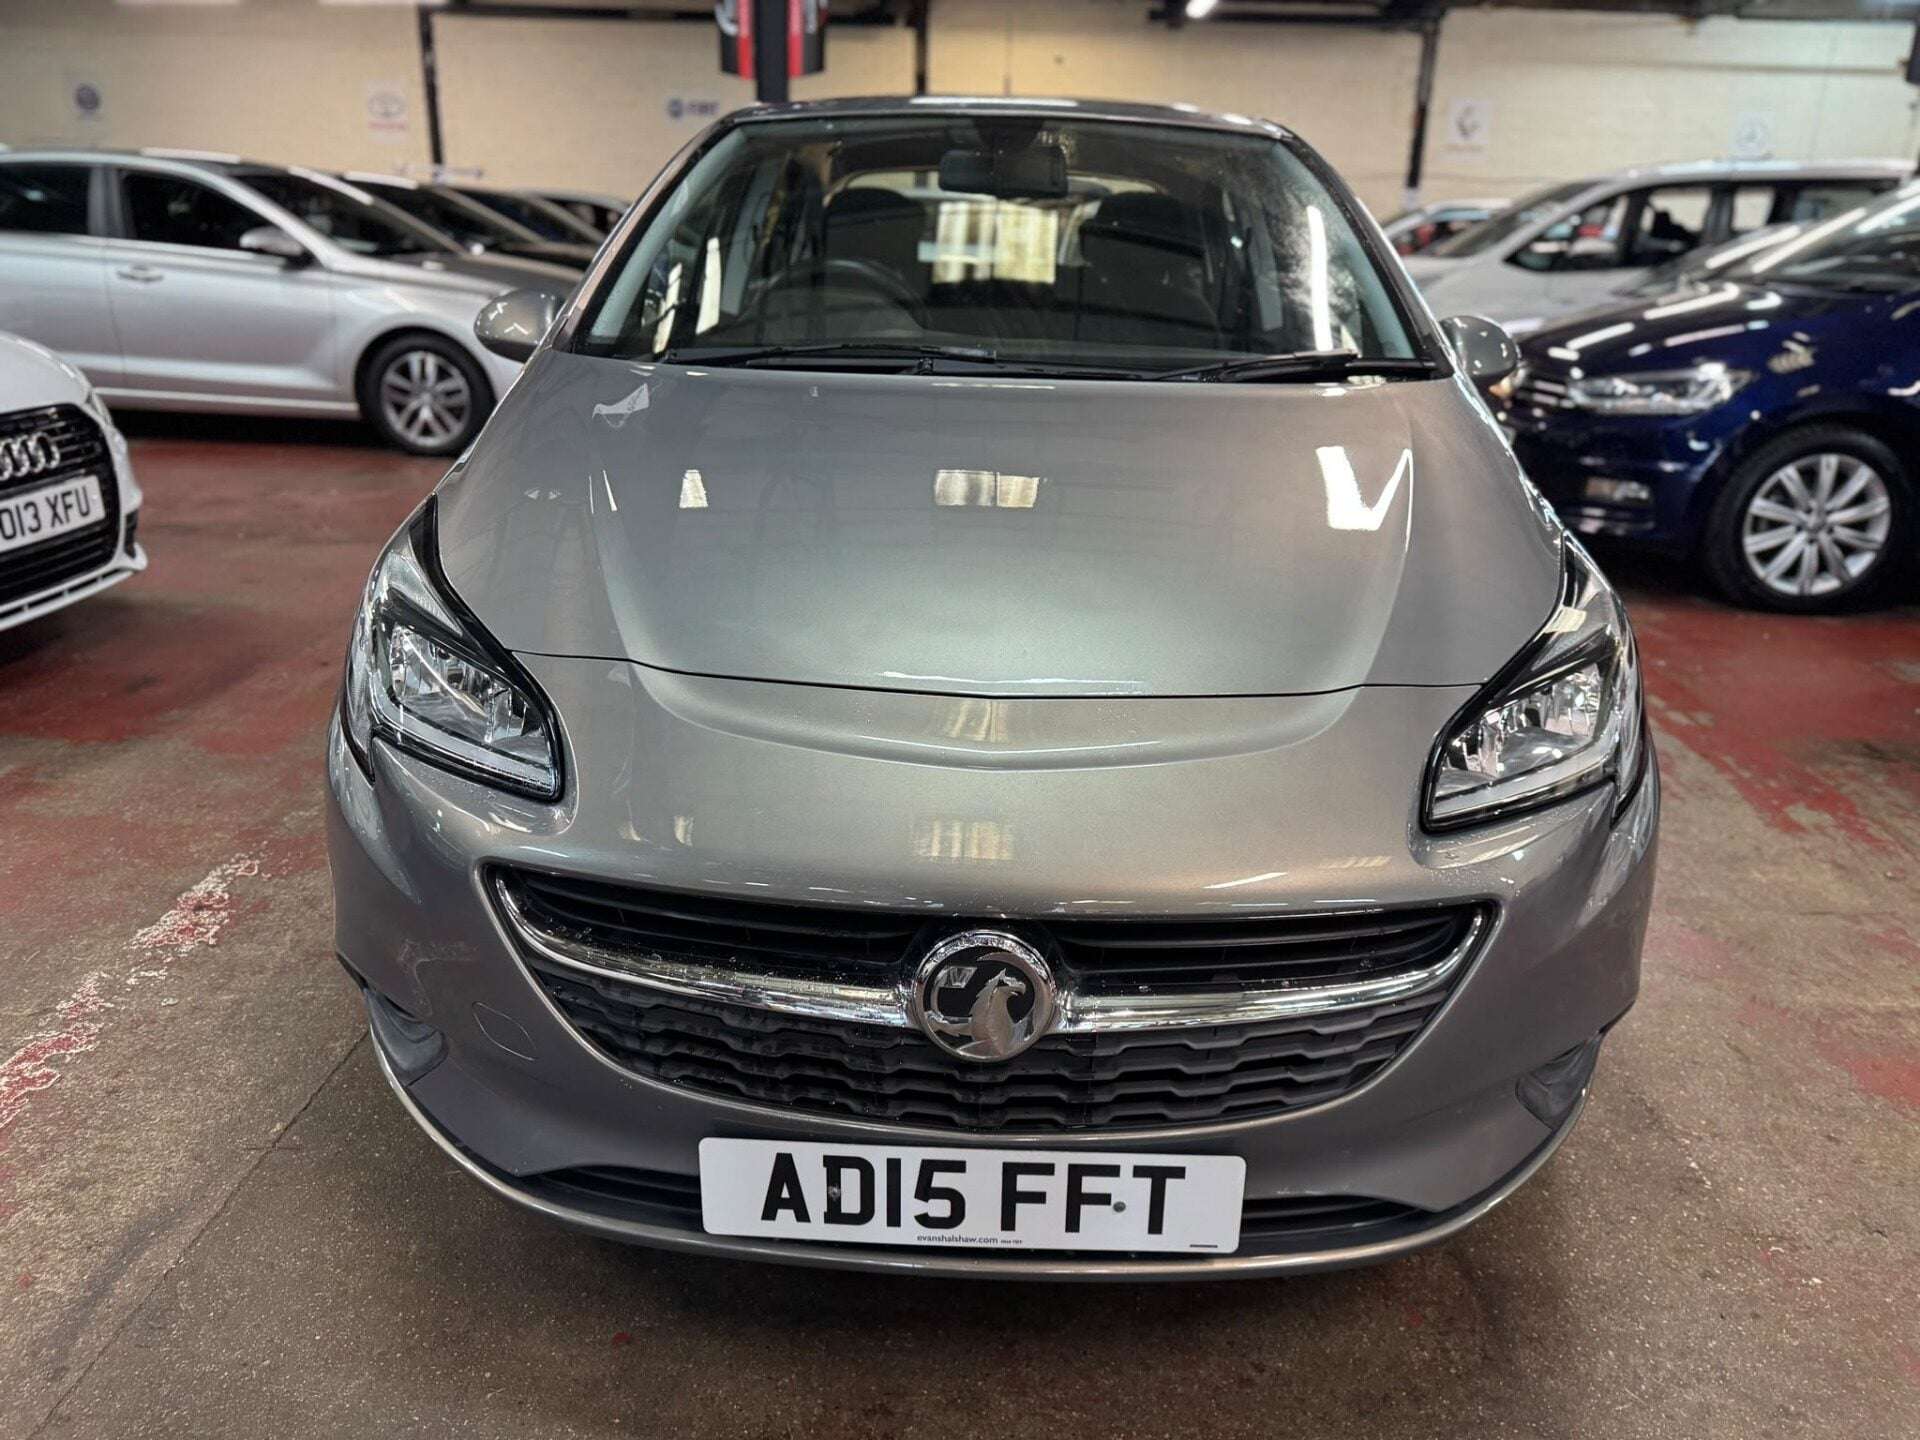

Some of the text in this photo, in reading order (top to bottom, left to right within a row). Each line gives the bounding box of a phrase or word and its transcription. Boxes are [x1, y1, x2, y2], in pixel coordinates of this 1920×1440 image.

[45, 486, 90, 528] XFU
[761, 1152, 1187, 1235] AD15 FFT
[916, 1234, 999, 1245] evanshalshaw.com
